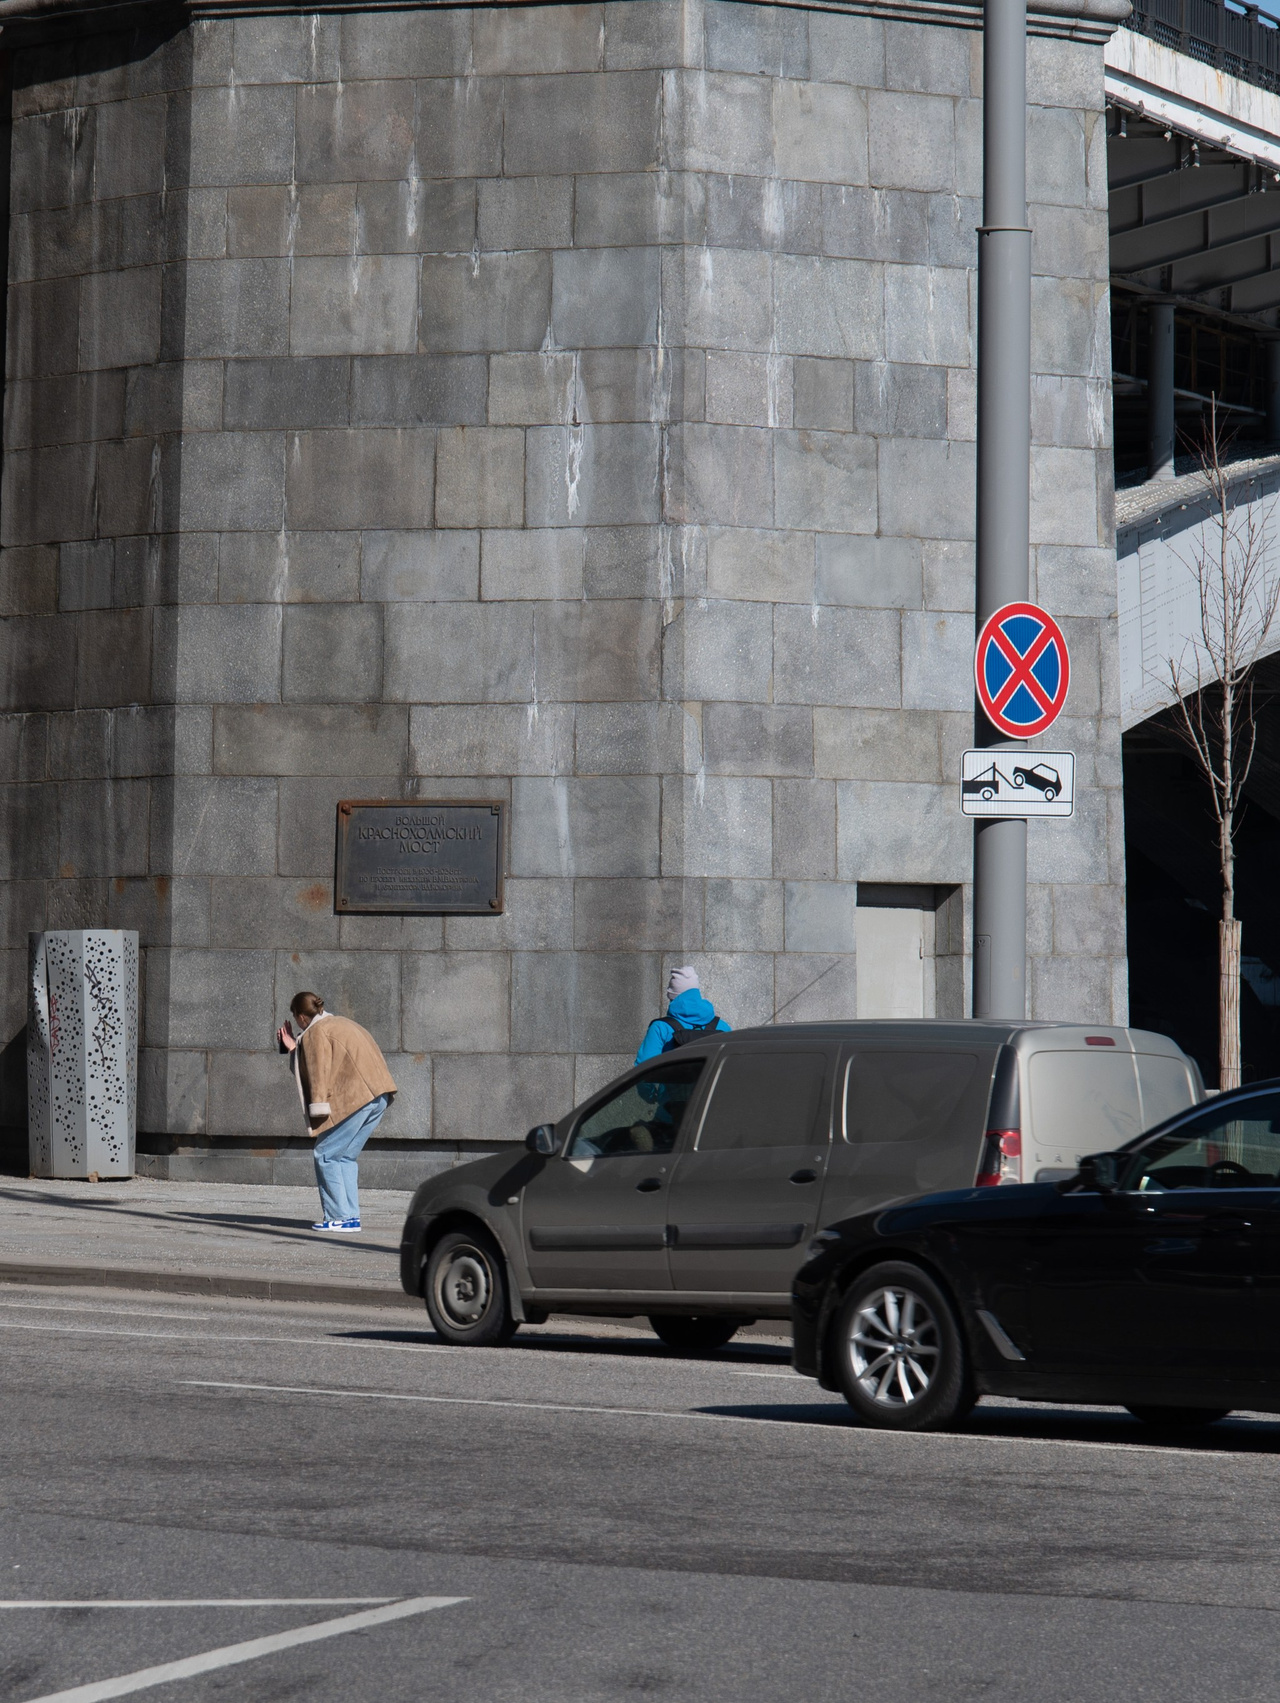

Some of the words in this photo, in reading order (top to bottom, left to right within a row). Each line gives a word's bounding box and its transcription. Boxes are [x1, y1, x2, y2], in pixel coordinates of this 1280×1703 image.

[395, 815, 445, 826] БОЛЬШОЙ
[358, 825, 482, 840] КРАСНОХОЛМСКИЙ
[399, 841, 441, 853] МОСТ
